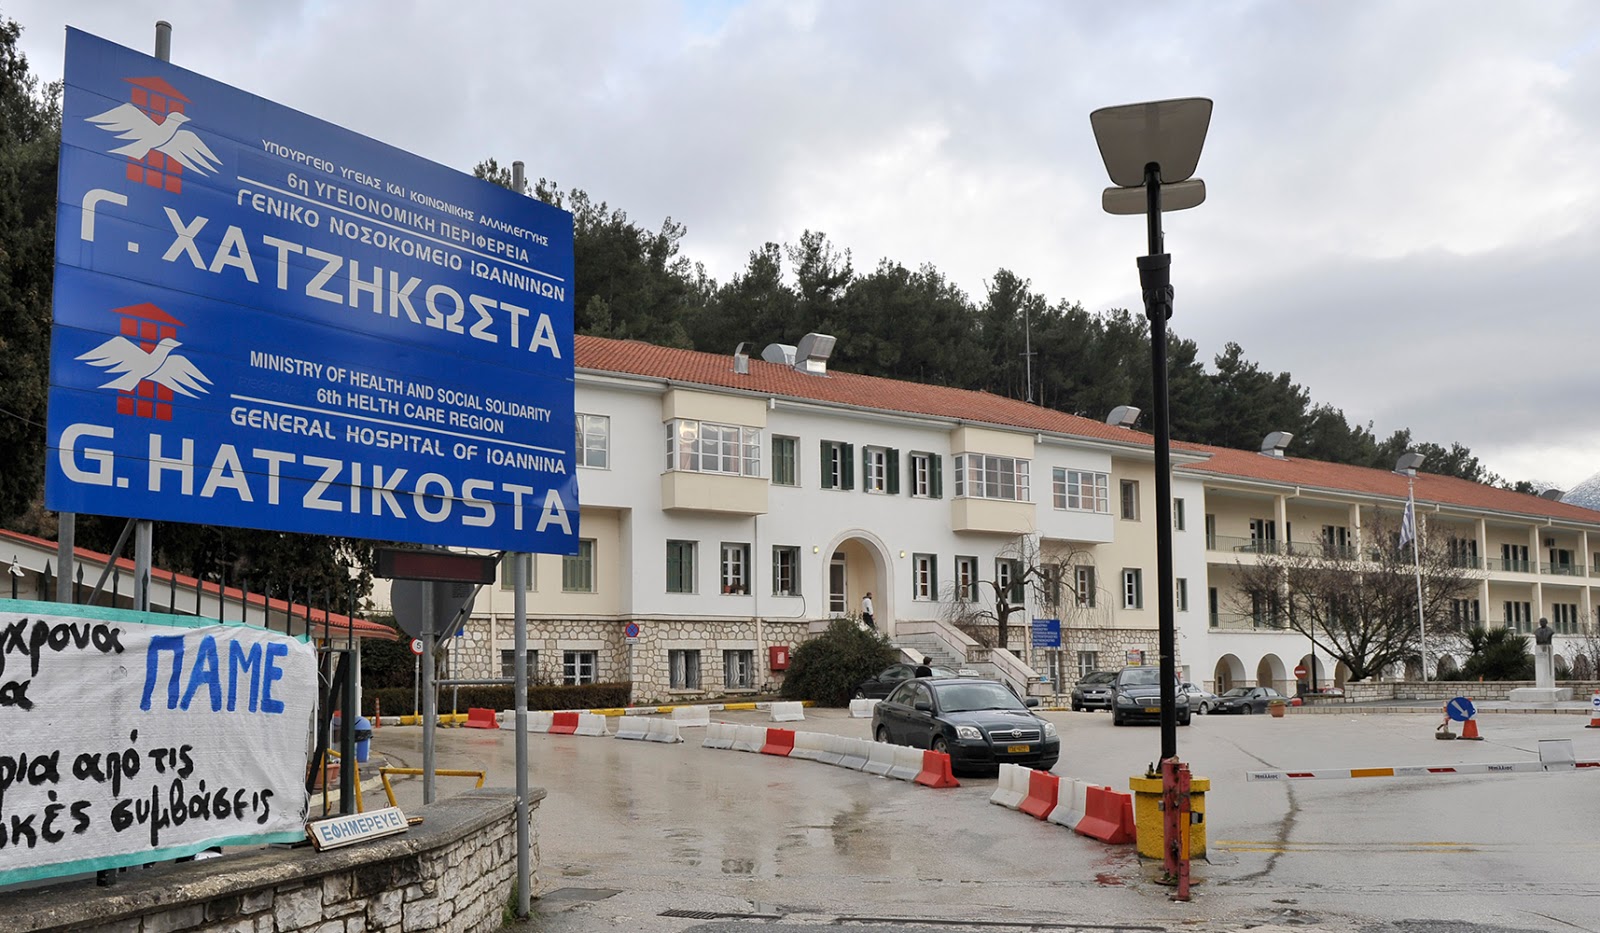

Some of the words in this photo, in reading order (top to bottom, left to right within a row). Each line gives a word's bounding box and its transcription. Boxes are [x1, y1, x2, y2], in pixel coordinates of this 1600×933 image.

[262, 139, 335, 173] ΥΠΟΥΡΓΕΙΟ
[340, 166, 382, 190] ΥΓΕΙΑΣ
[386, 182, 405, 199] ΚΑΙ
[410, 190, 475, 222] ΚΟΙΝΩΝΙΚΗΣ
[479, 215, 548, 247] ΑΛΛΗΛΕΓΓΥΗΣ
[288, 172, 309, 197] 6η
[315, 180, 435, 233] ΥΓΕΙΟΝΟΜΙΚΗ
[440, 221, 529, 263] ΠΕΡΙΦΕΡΕΙΑ
[80, 188, 139, 254] Γ.
[162, 205, 562, 359] ΧΑΤΖΗΚΩΣΤΑ
[237, 189, 319, 227] ΓΕΝΙΚΟ
[330, 217, 462, 271] ΝΟΣΟΚΟΜΕΙΟ
[470, 259, 565, 302] ΙΩΑΝΝΙΝΩΝ
[250, 350, 323, 379] MINISTRY
[326, 366, 347, 383] OF
[351, 371, 403, 395] HEALTH
[406, 382, 434, 401] AND
[438, 388, 483, 411] SOCIAL
[486, 398, 551, 423] SOLIDARITY
[317, 388, 342, 406] 6th
[347, 392, 399, 416] HELTH
[403, 403, 445, 424] CARE
[449, 411, 504, 434] REGION
[231, 406, 336, 440] GENERAL
[346, 425, 445, 457] HOSPITAL
[453, 443, 478, 461] OF
[486, 447, 566, 475] IOANNINA
[140, 634, 289, 714] ΠΑΜΕ
[73, 729, 140, 799] από
[148, 744, 194, 780] τις
[111, 778, 274, 847] συμβάσεις
[319, 811, 403, 842] ΕΦΗΜΕΡΕΥΕΙ
